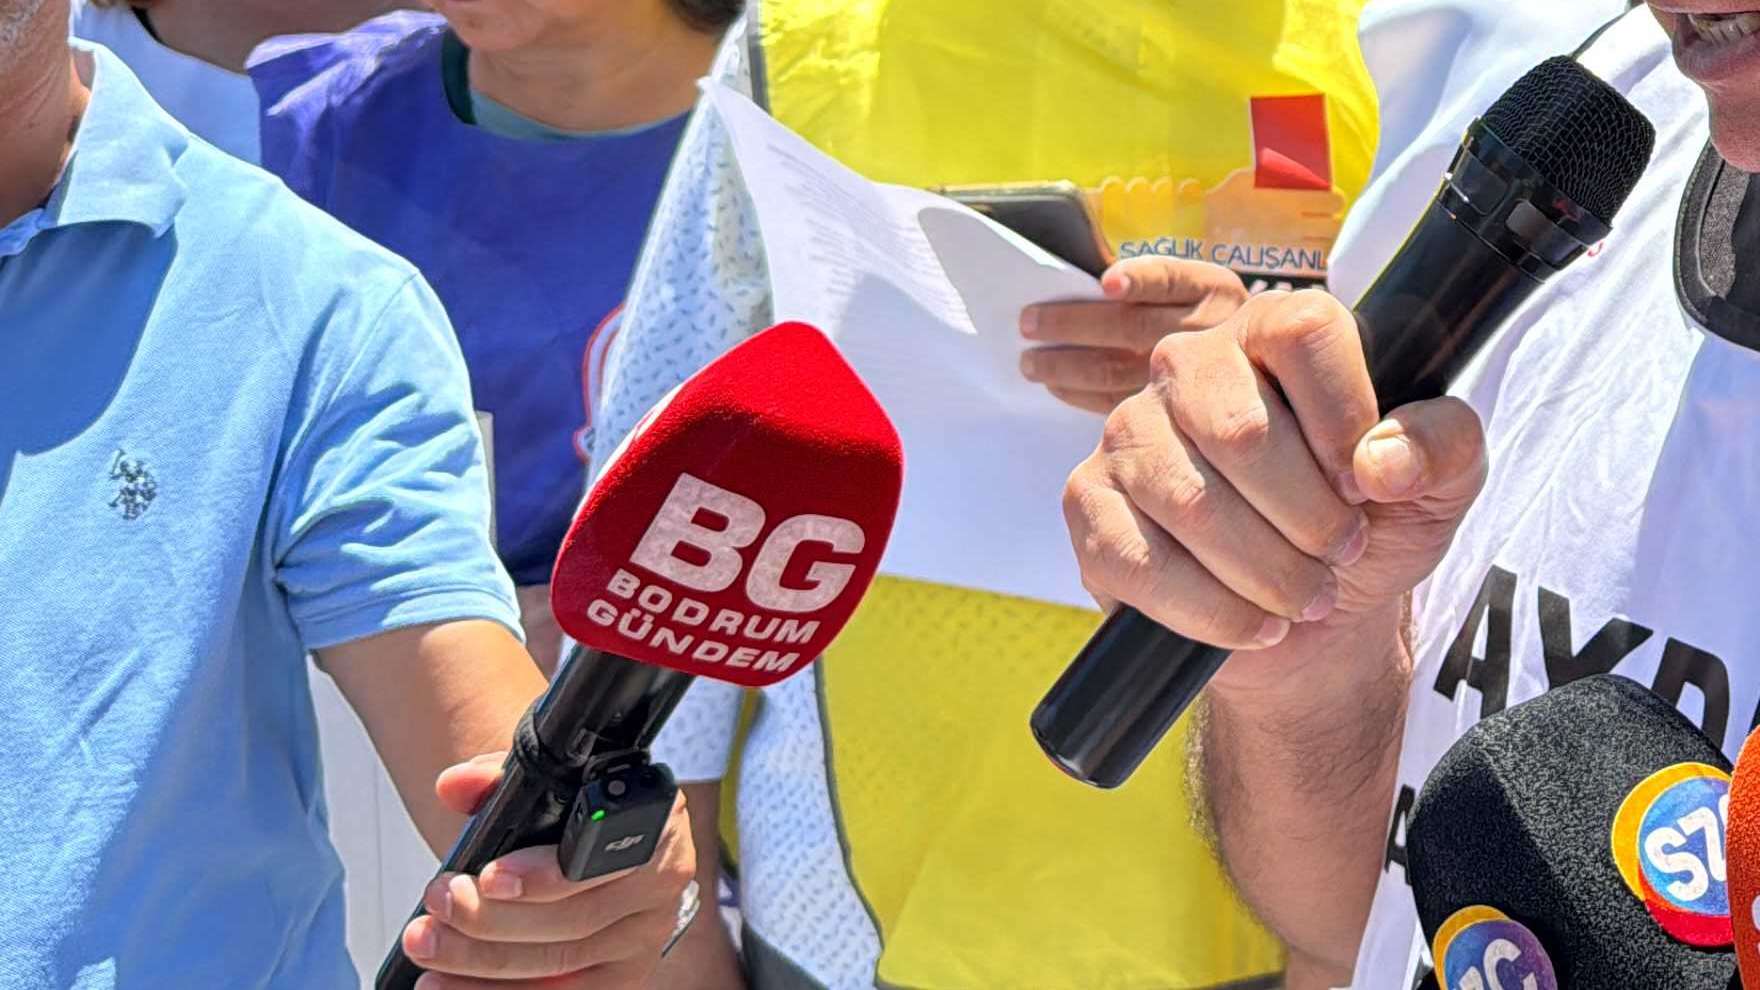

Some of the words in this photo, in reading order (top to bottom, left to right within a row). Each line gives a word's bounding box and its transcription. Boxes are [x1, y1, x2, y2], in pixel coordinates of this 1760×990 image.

[629, 472, 866, 613] BG
[586, 598, 800, 674] GÜNDEM
[606, 568, 821, 644] BODRUM
[1644, 794, 1728, 901] SZ
